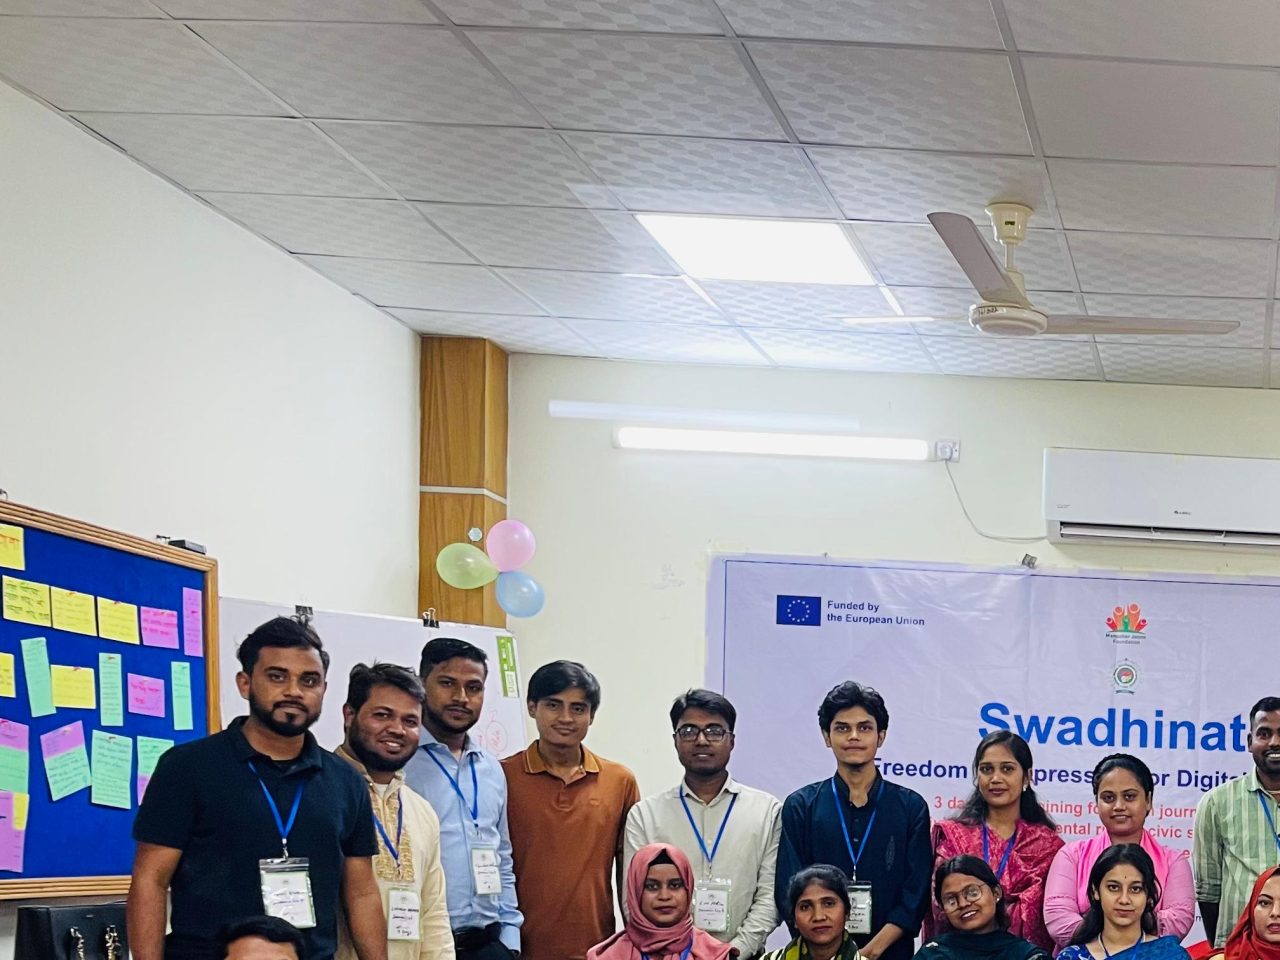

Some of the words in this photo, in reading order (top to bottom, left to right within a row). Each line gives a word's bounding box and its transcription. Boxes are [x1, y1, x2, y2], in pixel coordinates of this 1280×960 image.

[827, 601, 864, 610] Funded
[868, 602, 879, 613] by
[827, 613, 842, 622] the
[846, 614, 893, 625] European
[896, 617, 925, 626] Union
[979, 703, 1246, 752] Swadhinat
[1034, 769, 1093, 786] press
[1151, 773, 1170, 786] or
[1178, 770, 1247, 792] Digit
[934, 796, 942, 808] 3
[1045, 801, 1082, 817] ining
[1159, 805, 1196, 819] journ
[1056, 823, 1090, 835] ental
[1149, 825, 1182, 838] civic
